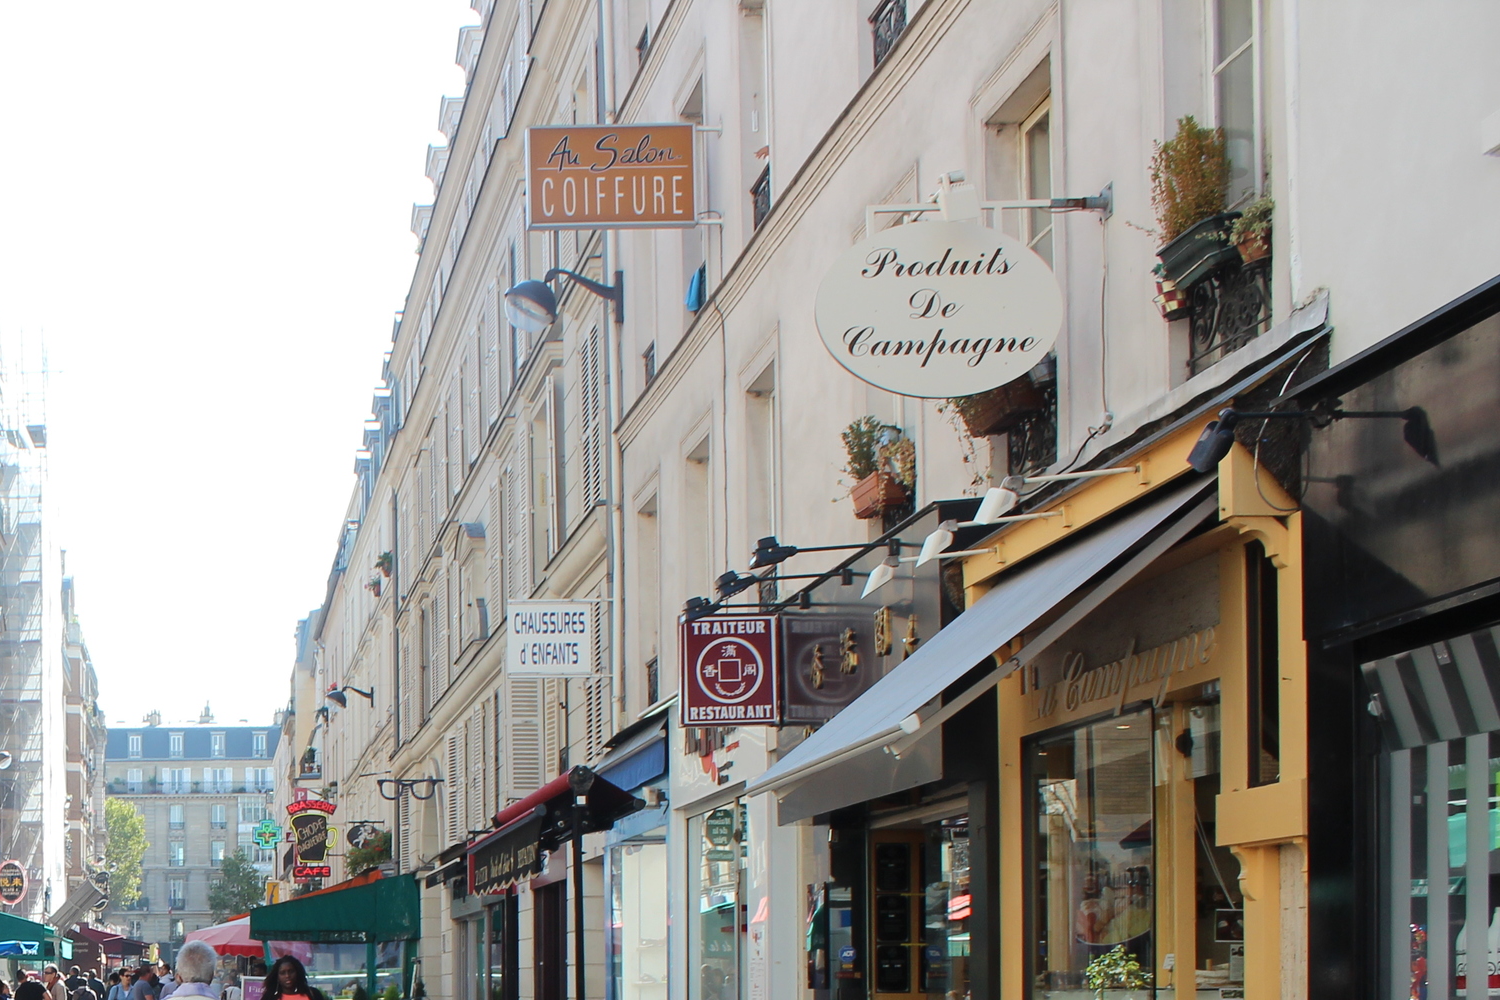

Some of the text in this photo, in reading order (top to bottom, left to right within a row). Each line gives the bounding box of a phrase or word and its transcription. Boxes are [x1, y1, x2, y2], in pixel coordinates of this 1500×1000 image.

[547, 134, 581, 173] Au
[542, 175, 683, 217] COIFFURE
[861, 247, 1018, 279] Produits
[909, 288, 965, 320] De
[842, 326, 1042, 368] Campagne
[513, 612, 586, 635] CHAUSSURES
[692, 621, 766, 635] TRAITEUR
[532, 643, 579, 665] ENFANTS
[1062, 625, 1217, 717] Campagne
[690, 705, 772, 720] RESTAURANT
[287, 801, 335, 813] BRASSERIE
[297, 818, 326, 841] CHOPE
[298, 830, 328, 854] DAGUERRE
[295, 867, 330, 877] CAFE
